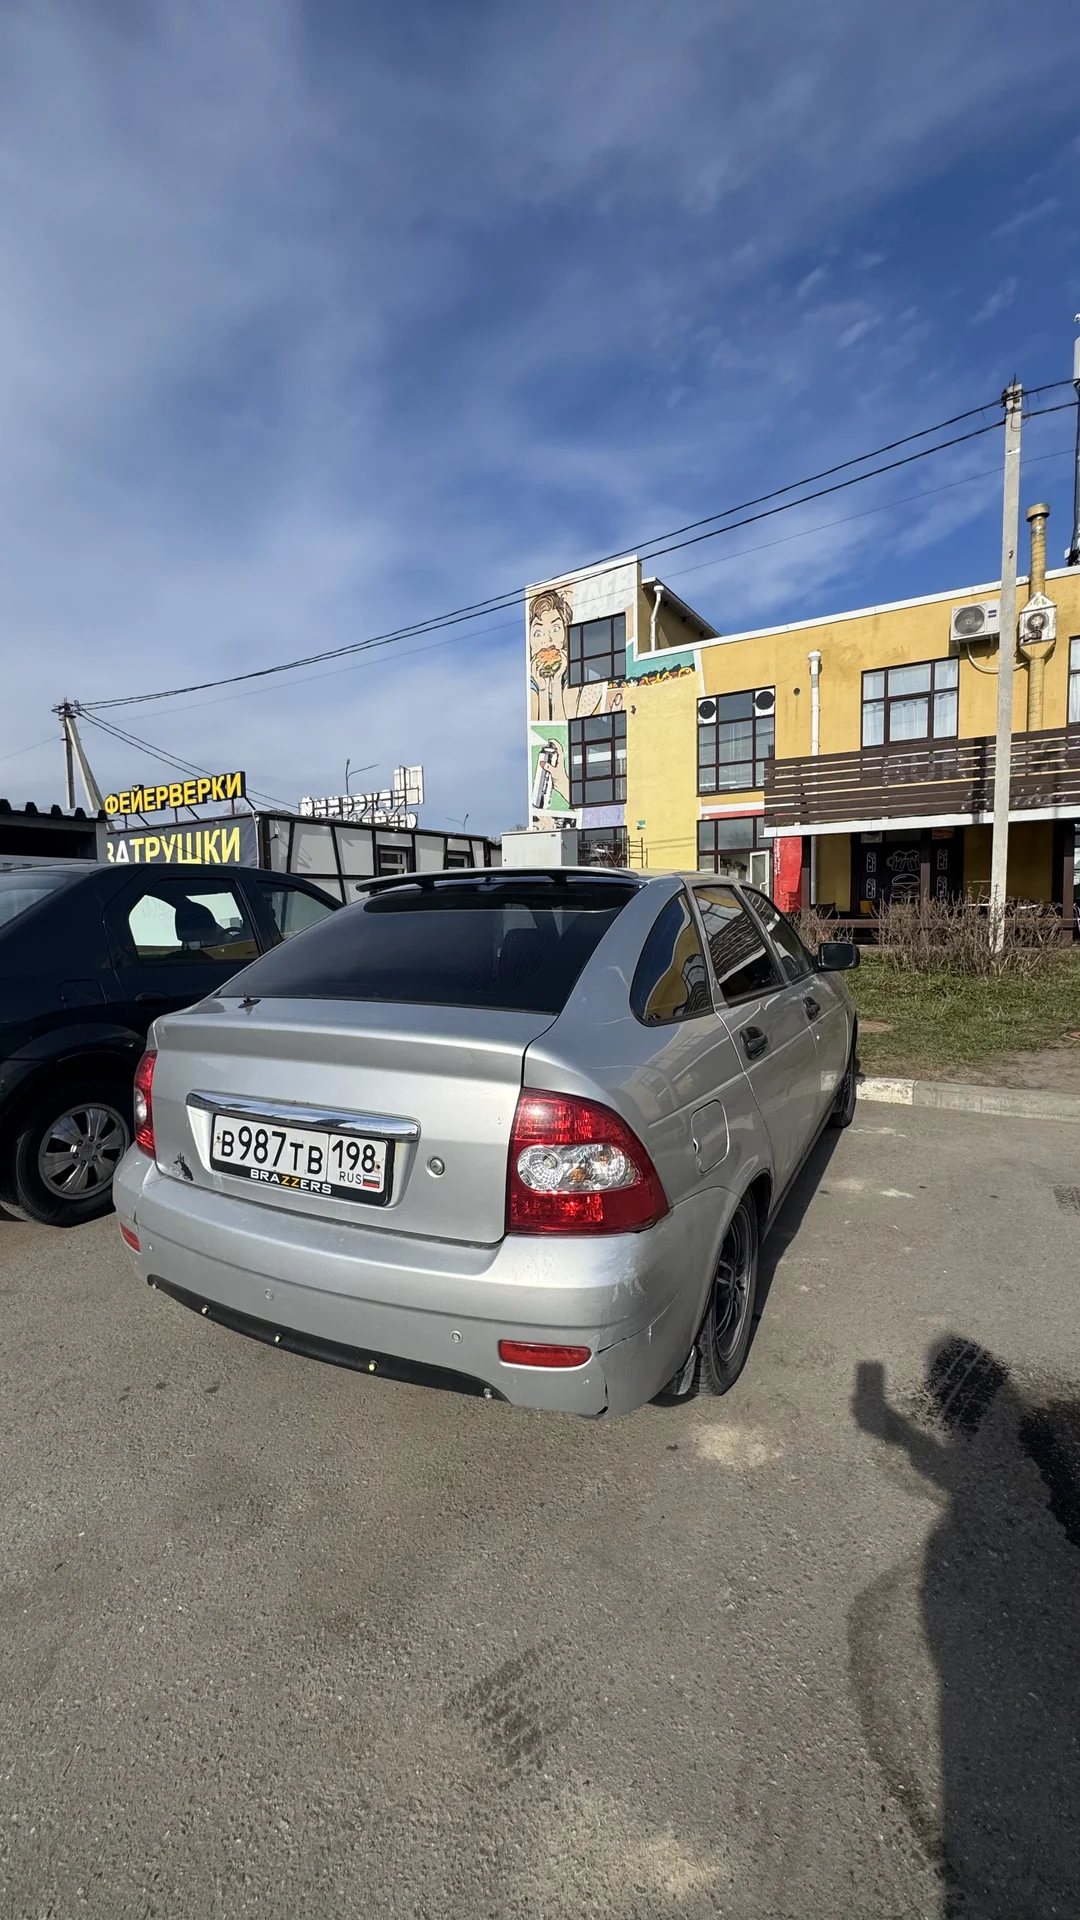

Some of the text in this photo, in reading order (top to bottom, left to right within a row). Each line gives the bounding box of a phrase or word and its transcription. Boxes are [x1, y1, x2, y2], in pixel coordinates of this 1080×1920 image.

[104, 771, 242, 815] ФЕЙЕРВЕРКИ
[332, 1140, 376, 1174] 198
[250, 1170, 332, 1194] BRAZZERS
[339, 1171, 362, 1185] RUS
